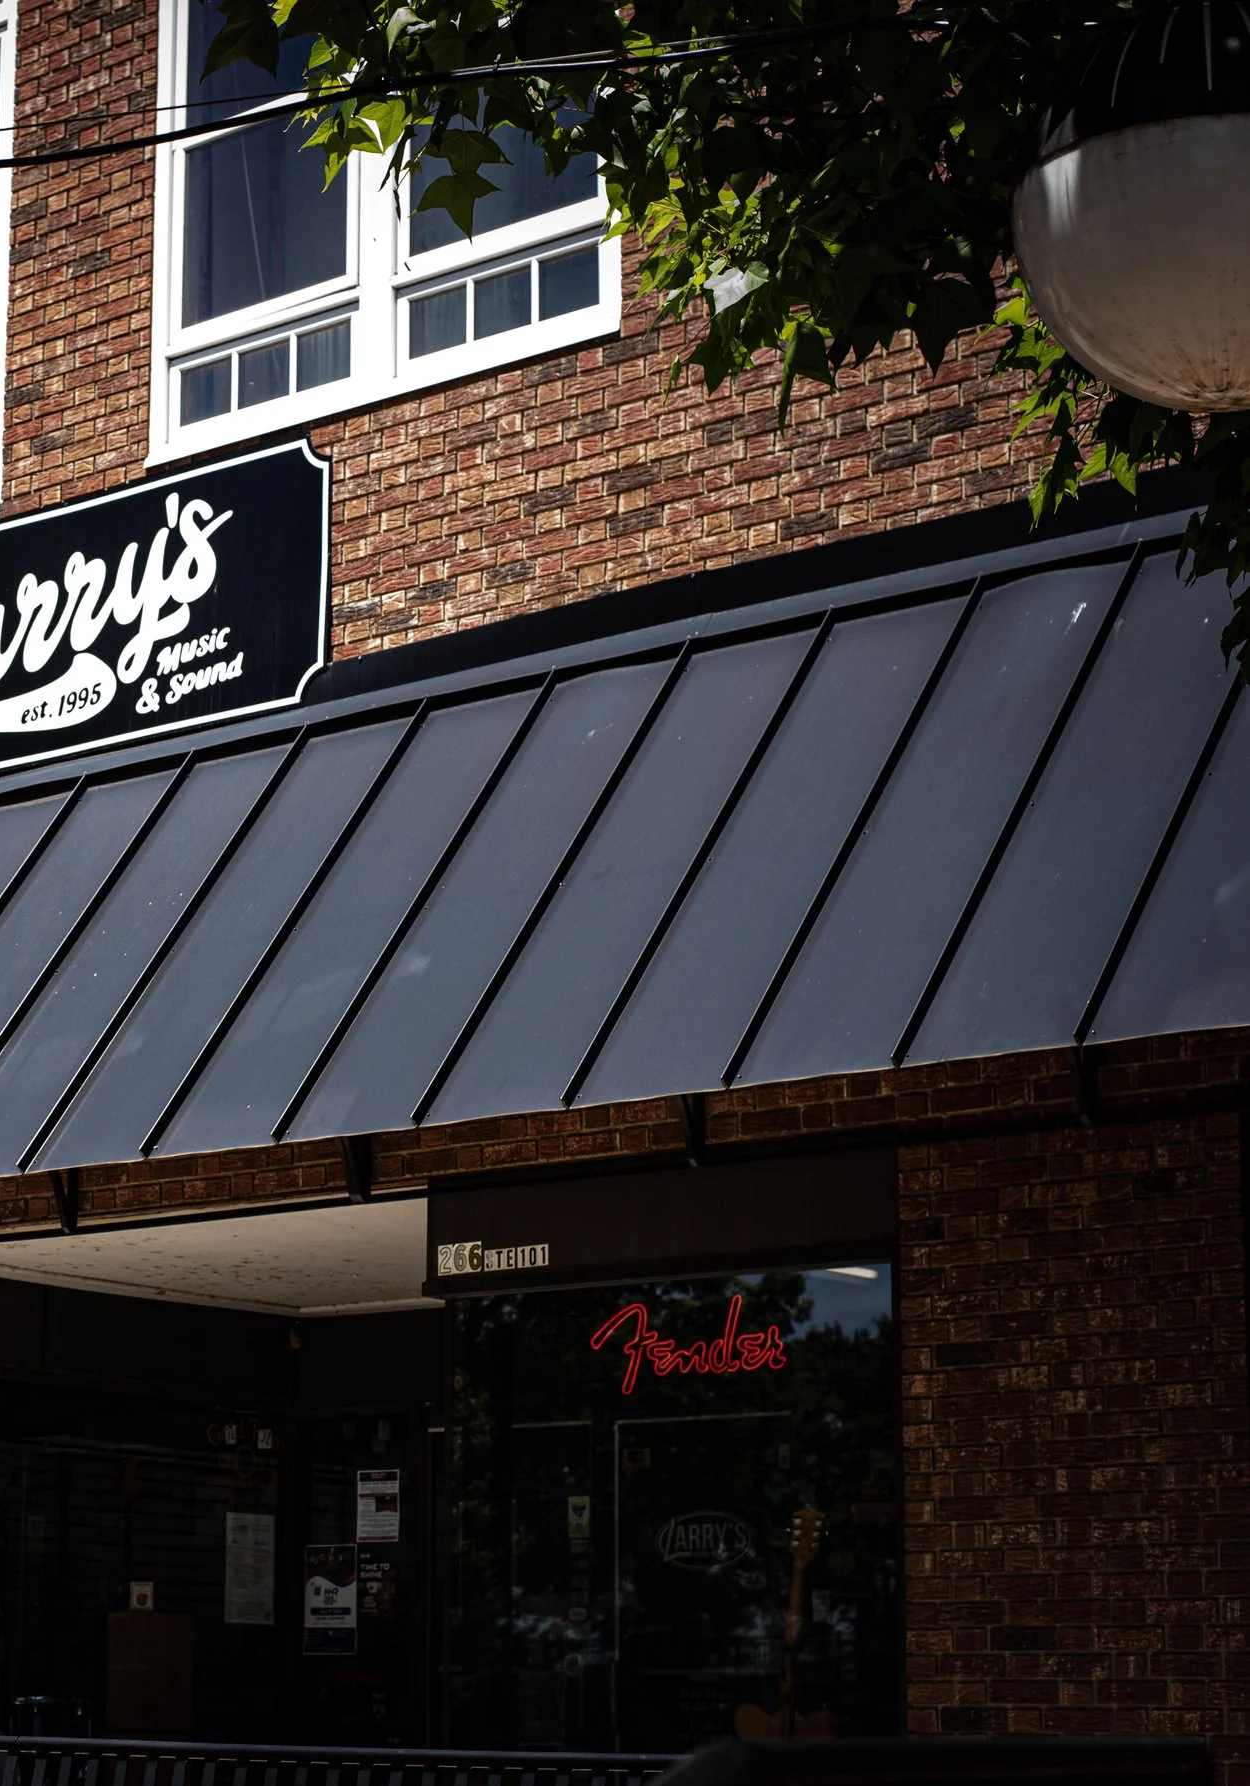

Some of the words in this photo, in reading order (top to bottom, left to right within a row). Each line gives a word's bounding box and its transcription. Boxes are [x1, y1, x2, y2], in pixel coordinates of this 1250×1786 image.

[156, 626, 231, 677] Music
[20, 700, 53, 725] est.
[57, 682, 102, 717] 1995
[135, 677, 161, 715] &
[165, 651, 244, 705] Sound
[439, 1243, 482, 1275] 266
[520, 1246, 547, 1267] 101
[589, 1293, 787, 1396] Fender
[658, 1516, 746, 1562] LARRY'S
